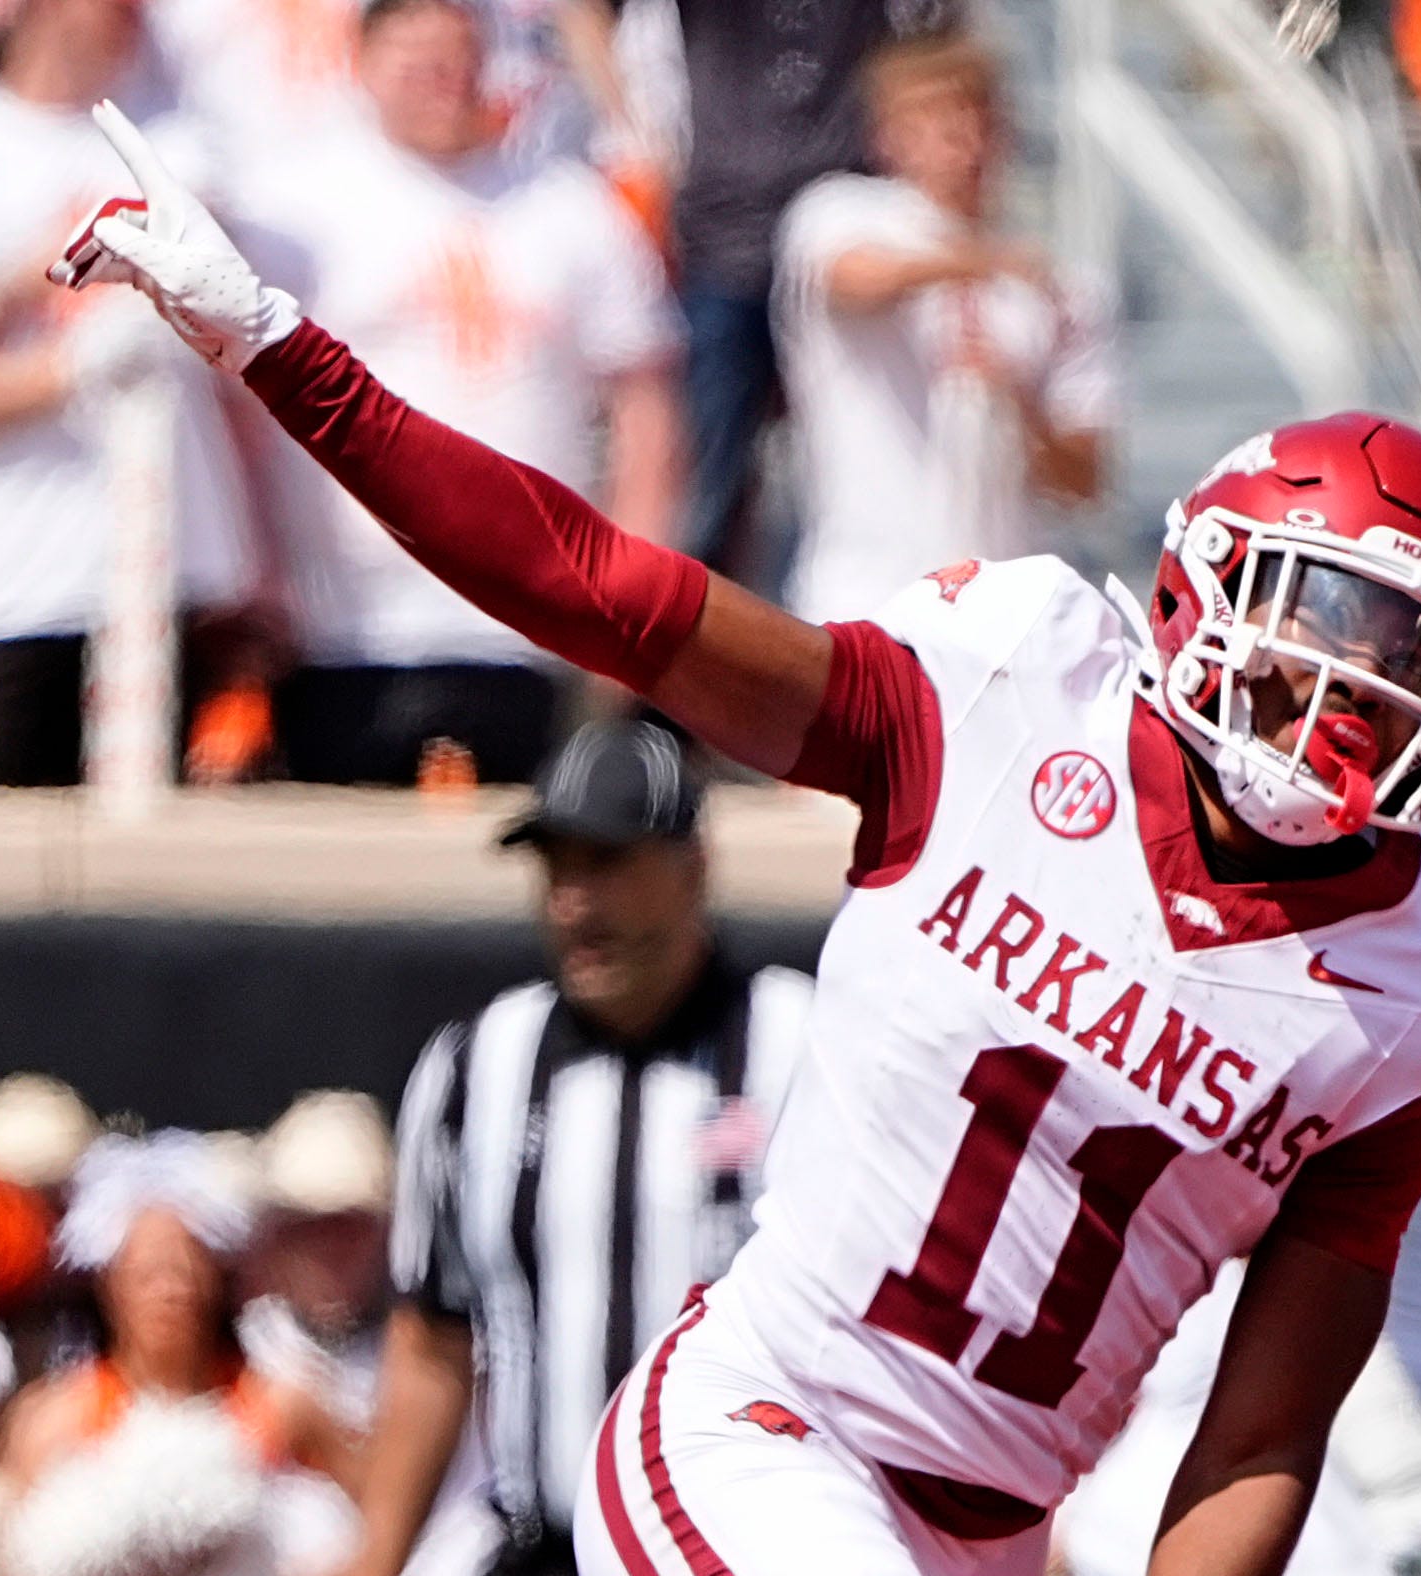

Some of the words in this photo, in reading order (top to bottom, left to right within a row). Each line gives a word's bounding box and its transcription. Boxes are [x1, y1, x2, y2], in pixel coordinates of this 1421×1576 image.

[1032, 753, 1114, 835] SEC
[917, 866, 1334, 1188] ARKANSAS
[862, 1043, 1186, 1409] 11
